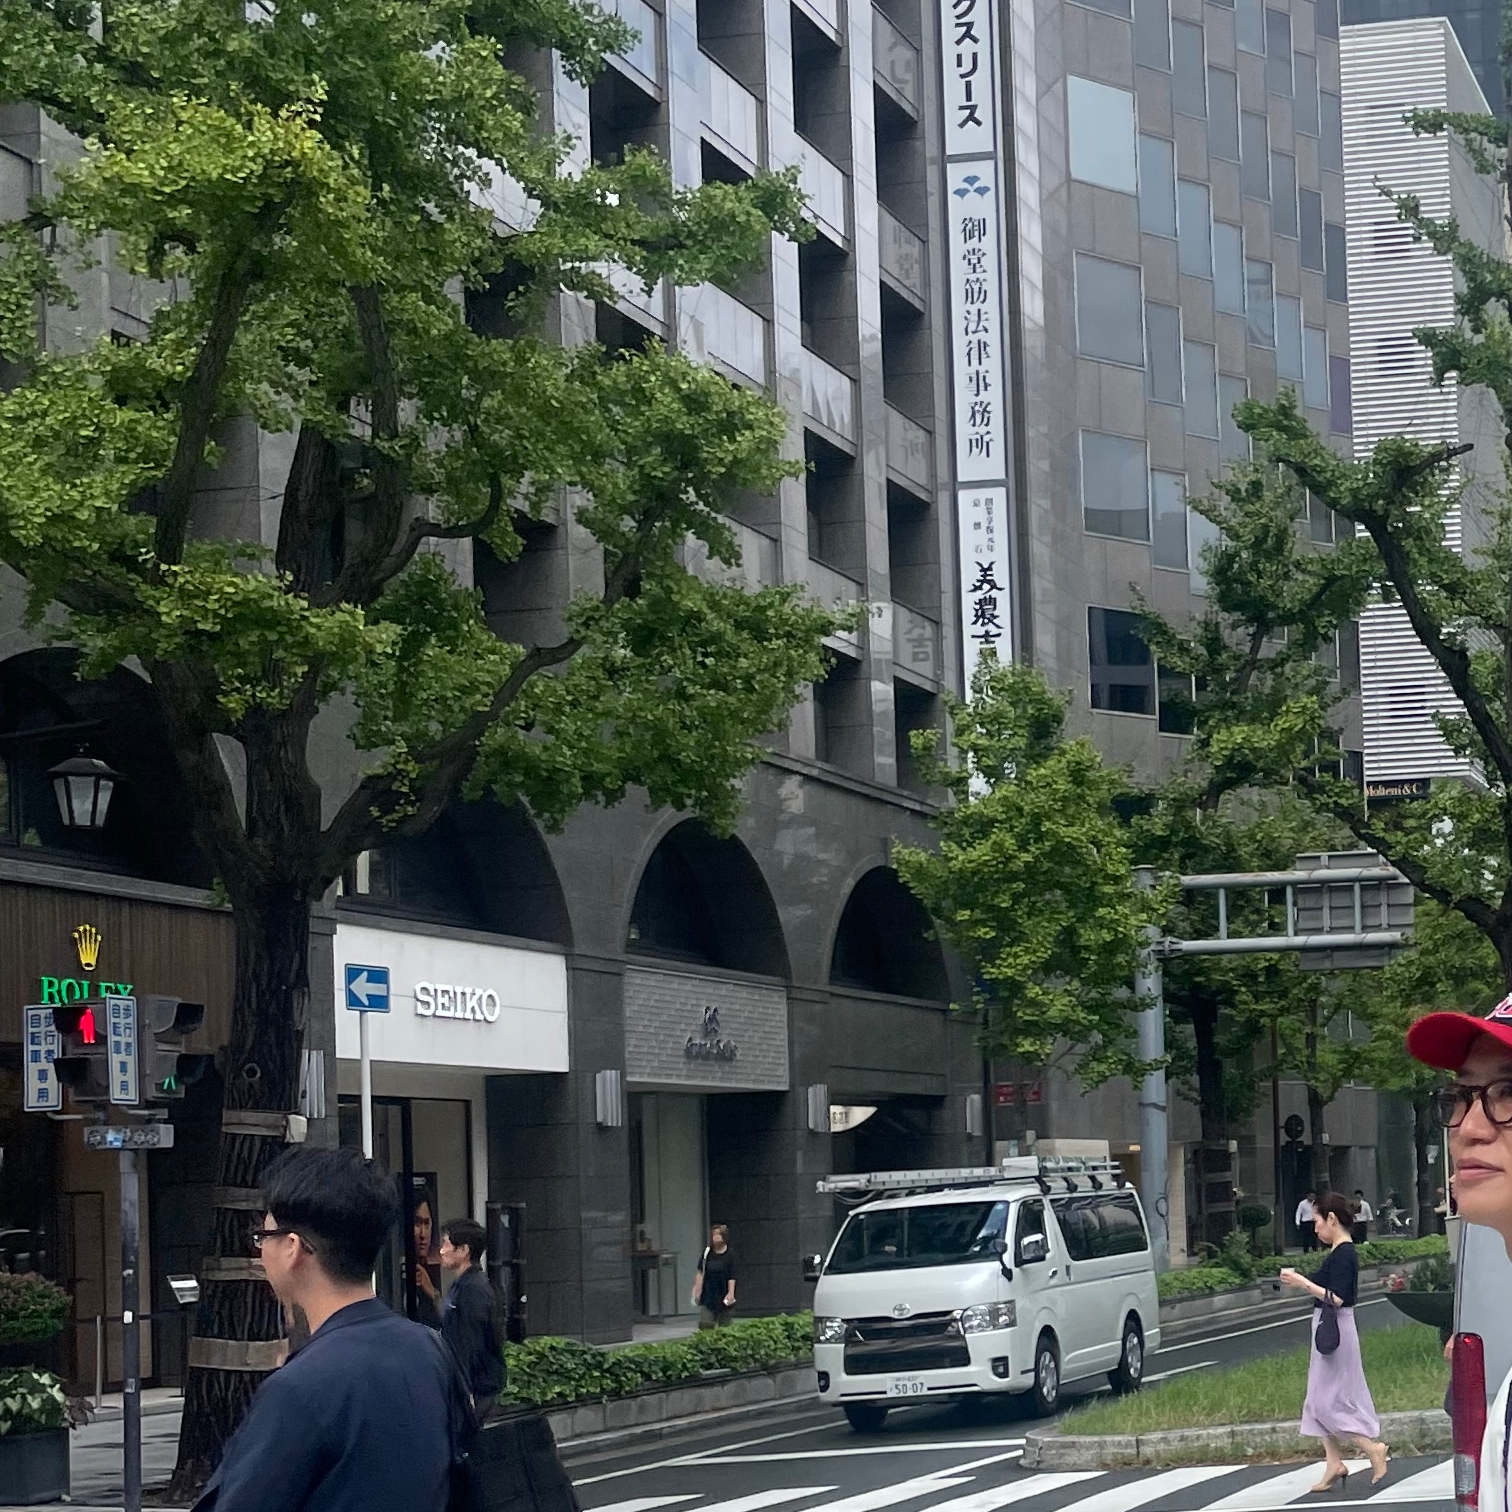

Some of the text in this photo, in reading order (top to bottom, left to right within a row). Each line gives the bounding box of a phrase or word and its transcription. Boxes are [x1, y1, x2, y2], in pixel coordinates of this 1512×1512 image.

[960, 216, 994, 459] 御堂筋法律事務所
[414, 981, 501, 1023] SEIKO
[30, 1015, 42, 1063] 自転車
[112, 1004, 122, 1055] 自転車
[123, 1004, 133, 1056] 歩行者
